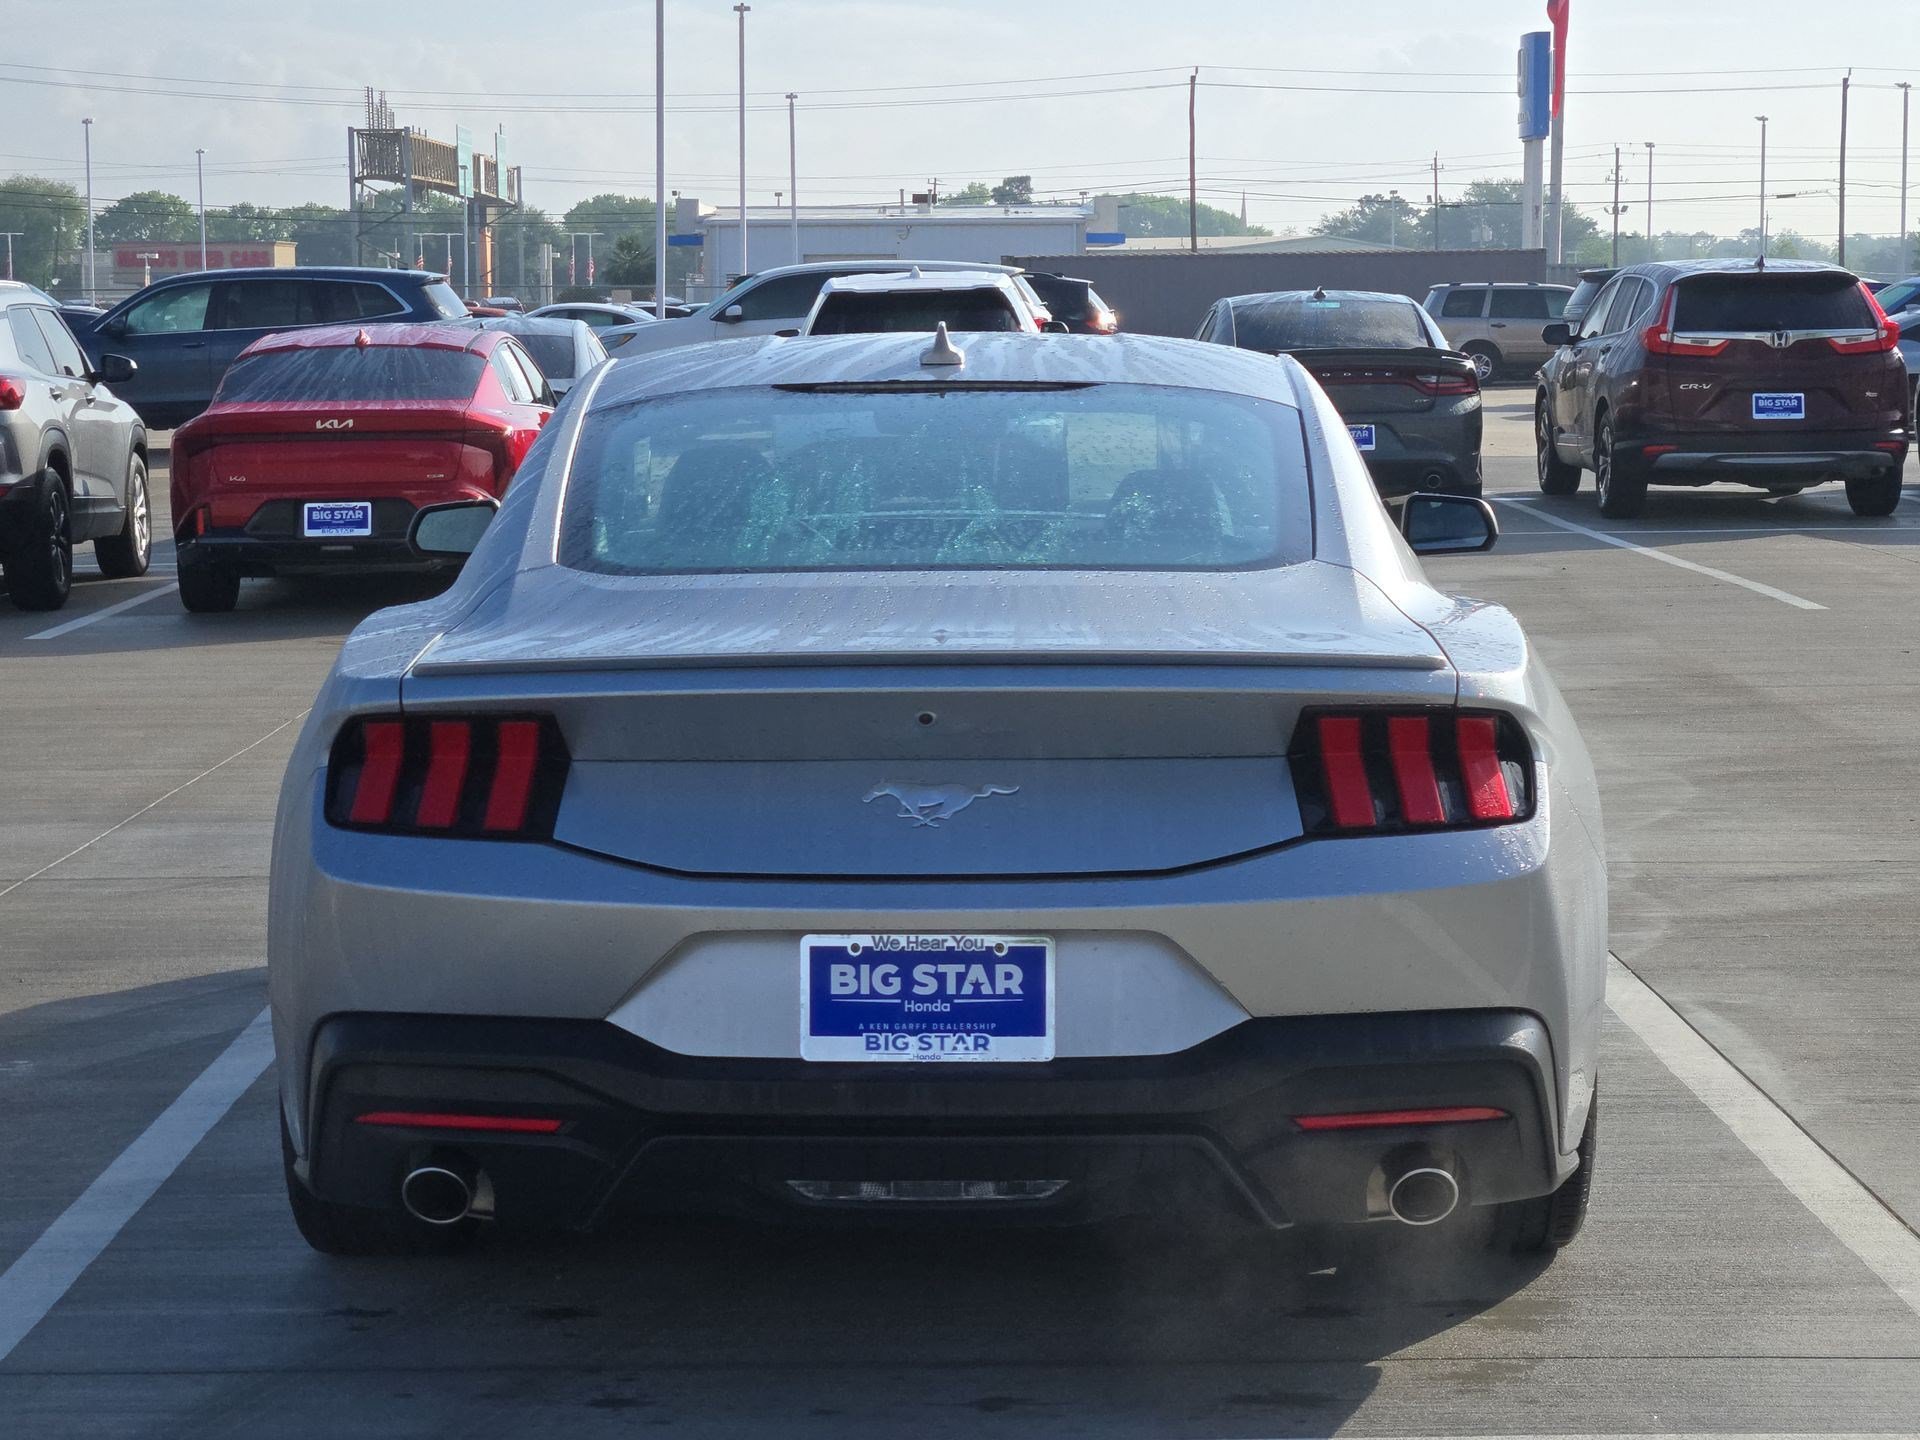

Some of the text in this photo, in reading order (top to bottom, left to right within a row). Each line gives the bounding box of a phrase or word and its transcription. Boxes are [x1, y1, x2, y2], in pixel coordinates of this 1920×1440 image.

[1758, 399, 1798, 407] BIG STAR
[1350, 430, 1369, 438] TAR
[312, 510, 364, 520] BIG STAR
[871, 935, 985, 950] We Hear You
[830, 963, 1024, 996] BIG STAR
[904, 1000, 951, 1012] Honda
[865, 1034, 990, 1051] BIG STAR
